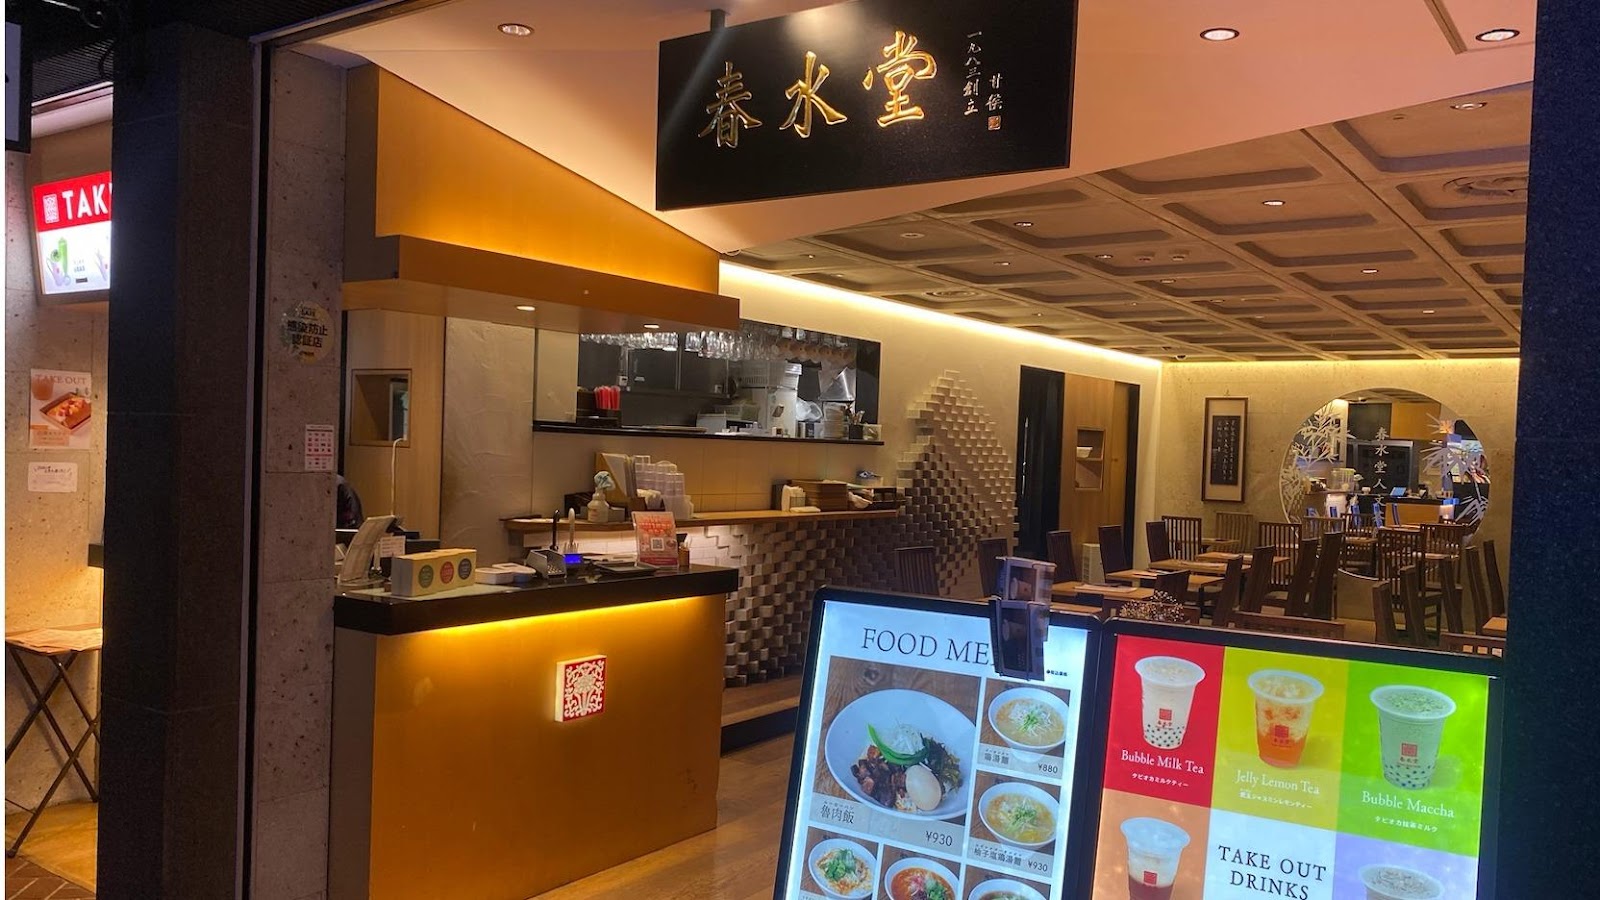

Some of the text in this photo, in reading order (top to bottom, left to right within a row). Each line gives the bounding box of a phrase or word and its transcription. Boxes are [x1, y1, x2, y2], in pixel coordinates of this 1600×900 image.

[963, 31, 982, 116] 一九八三創立
[698, 30, 938, 150] 春水堂
[62, 182, 112, 220] TAK
[65, 377, 87, 386] OUT
[861, 627, 995, 666] FOOD ME
[1038, 763, 1058, 774] ¥880
[1121, 749, 1204, 774] Bubble Milk Tea
[1235, 769, 1319, 795] Jelly Lemon Tea
[1362, 790, 1454, 818] Bubble Maccha
[925, 830, 953, 846] ¥930
[1028, 860, 1048, 872] ¥930
[1218, 845, 1327, 882] TAKE OUT
[1229, 870, 1309, 900] DRINKS
